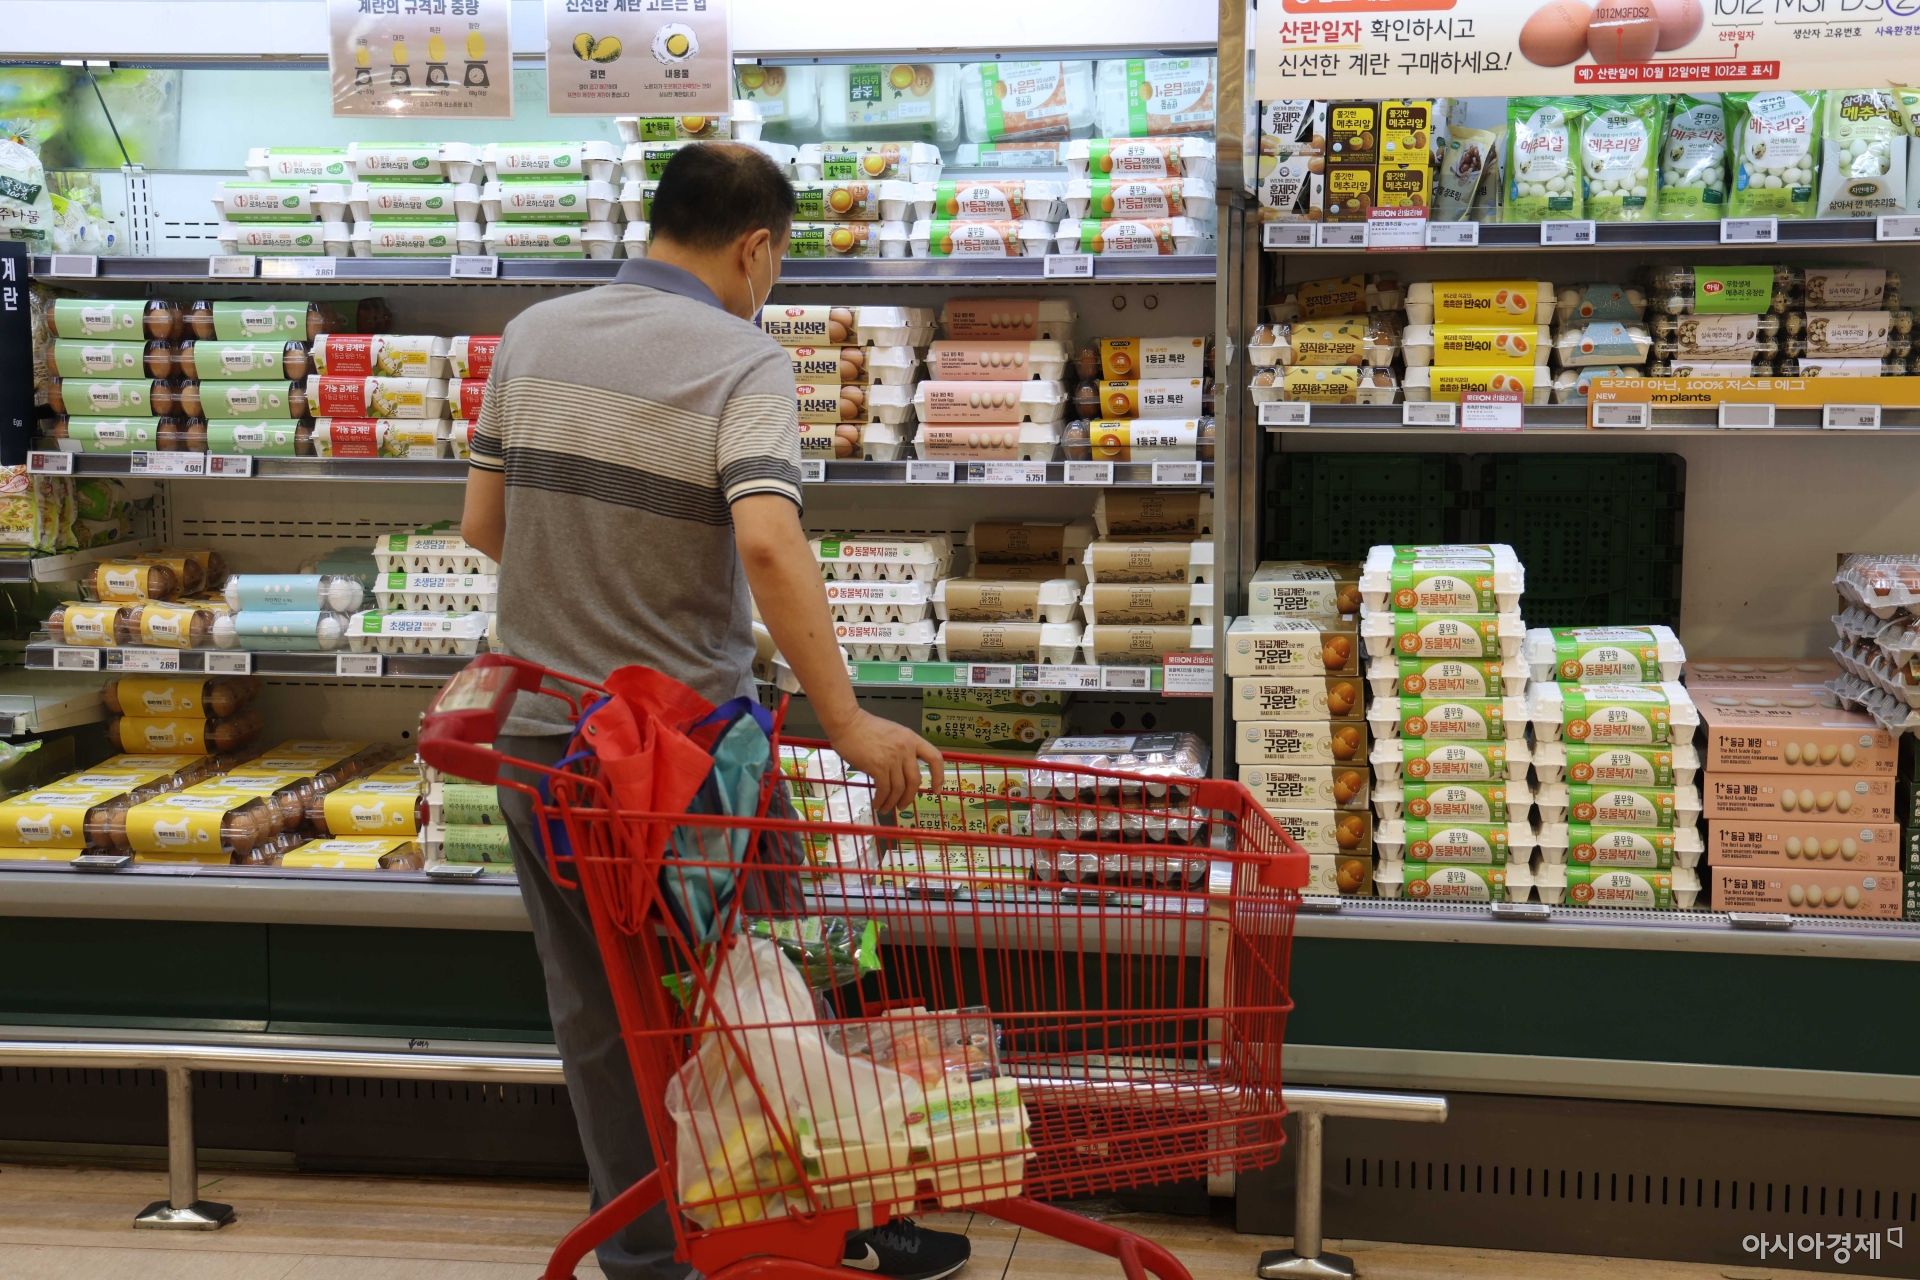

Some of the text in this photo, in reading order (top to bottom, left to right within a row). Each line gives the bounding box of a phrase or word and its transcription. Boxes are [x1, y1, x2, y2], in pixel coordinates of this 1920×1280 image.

[359, 0, 479, 15] 계란의 규격과 중량
[1596, 6, 1649, 20] 1012M3FDS2
[1280, 18, 1476, 44] 산란일자 확인하시고
[1719, 30, 1755, 42] 산란일자
[1793, 26, 1862, 39] 생산자 고유번호
[1279, 52, 1512, 77] 신선한 계란 구매하세요!
[665, 70, 689, 78] 내용물
[1579, 65, 1773, 80] 예) 산란일이 10월 12일이면 1012로 표시
[1272, 112, 1300, 123] 훈제맛
[1390, 110, 1409, 118] 쫄깃한
[1273, 123, 1293, 135] 계란
[1337, 119, 1372, 129] 메추리알
[1750, 116, 1806, 134] 메추리알
[1521, 136, 1564, 153] 메추리알
[1334, 173, 1354, 181] 쫄깃한
[1386, 172, 1406, 180] 쫄깃한
[1270, 184, 1298, 195] 훈제맛
[1333, 181, 1368, 191] 메추리알
[1270, 195, 1291, 206] 계란
[1829, 198, 1896, 210] 삶아서 깐 메추리알
[962, 200, 987, 213] 1+등급
[2, 258, 18, 311] 계란
[1707, 283, 1719, 291] 하림
[1745, 289, 1765, 297] 유정란
[1443, 298, 1491, 309] 촉촉한 반숙이
[764, 322, 826, 335] 1등급 신선란
[1299, 343, 1356, 354] 정직한구운란
[1444, 341, 1491, 351] 촉촉한 반숙이
[1168, 354, 1185, 363] 특란
[804, 361, 837, 374] 신선란
[324, 385, 359, 393] 가농 금계란
[1291, 383, 1348, 395] 정직한구운란
[1440, 382, 1487, 392] 촉촉한 반숙이
[1647, 380, 1805, 391] 아닌, 100% 저스트 에그
[1144, 395, 1184, 404] 1등급 특란
[1670, 393, 1712, 403] plants
[804, 400, 836, 412] 신선란
[13, 419, 22, 427] Egg
[336, 426, 370, 434] 가농 금계란
[800, 438, 831, 450] 신선란
[1160, 437, 1177, 446] 특란
[414, 540, 445, 550] 초생달걀
[855, 546, 884, 557] 동물복지
[1130, 558, 1150, 566] 유정란
[413, 577, 445, 587] 초생달걀
[1434, 580, 1454, 591] 풀무원
[840, 588, 870, 598] 동물복지
[981, 596, 1000, 604] 유정란
[1274, 597, 1309, 611] 구운란
[390, 621, 422, 631] 초생달걀
[848, 627, 878, 637] 동물복지
[983, 638, 1002, 646] 유정란
[1255, 650, 1292, 663] 구운란
[976, 690, 993, 704] 유정
[994, 688, 1012, 701] 초란
[1260, 696, 1297, 709] 구운란
[1608, 710, 1628, 722] 풀무원
[944, 722, 1011, 740] 동물복지 유정 초란
[1593, 725, 1631, 737] 동물복지
[1264, 739, 1301, 753] 구운란
[1719, 735, 1762, 748] 1+등급 계란
[1611, 754, 1631, 766] 풀무원
[1266, 782, 1304, 797] 구운란
[1715, 782, 1758, 794] 1+등급 계란
[1613, 835, 1633, 847] 풀무원
[1719, 830, 1762, 842] 1+등급 계란
[1435, 846, 1471, 857] 동물복지
[1599, 849, 1636, 860] 동물복지
[1611, 875, 1631, 887] 풀무원
[1722, 877, 1765, 889] 1+등급 계란
